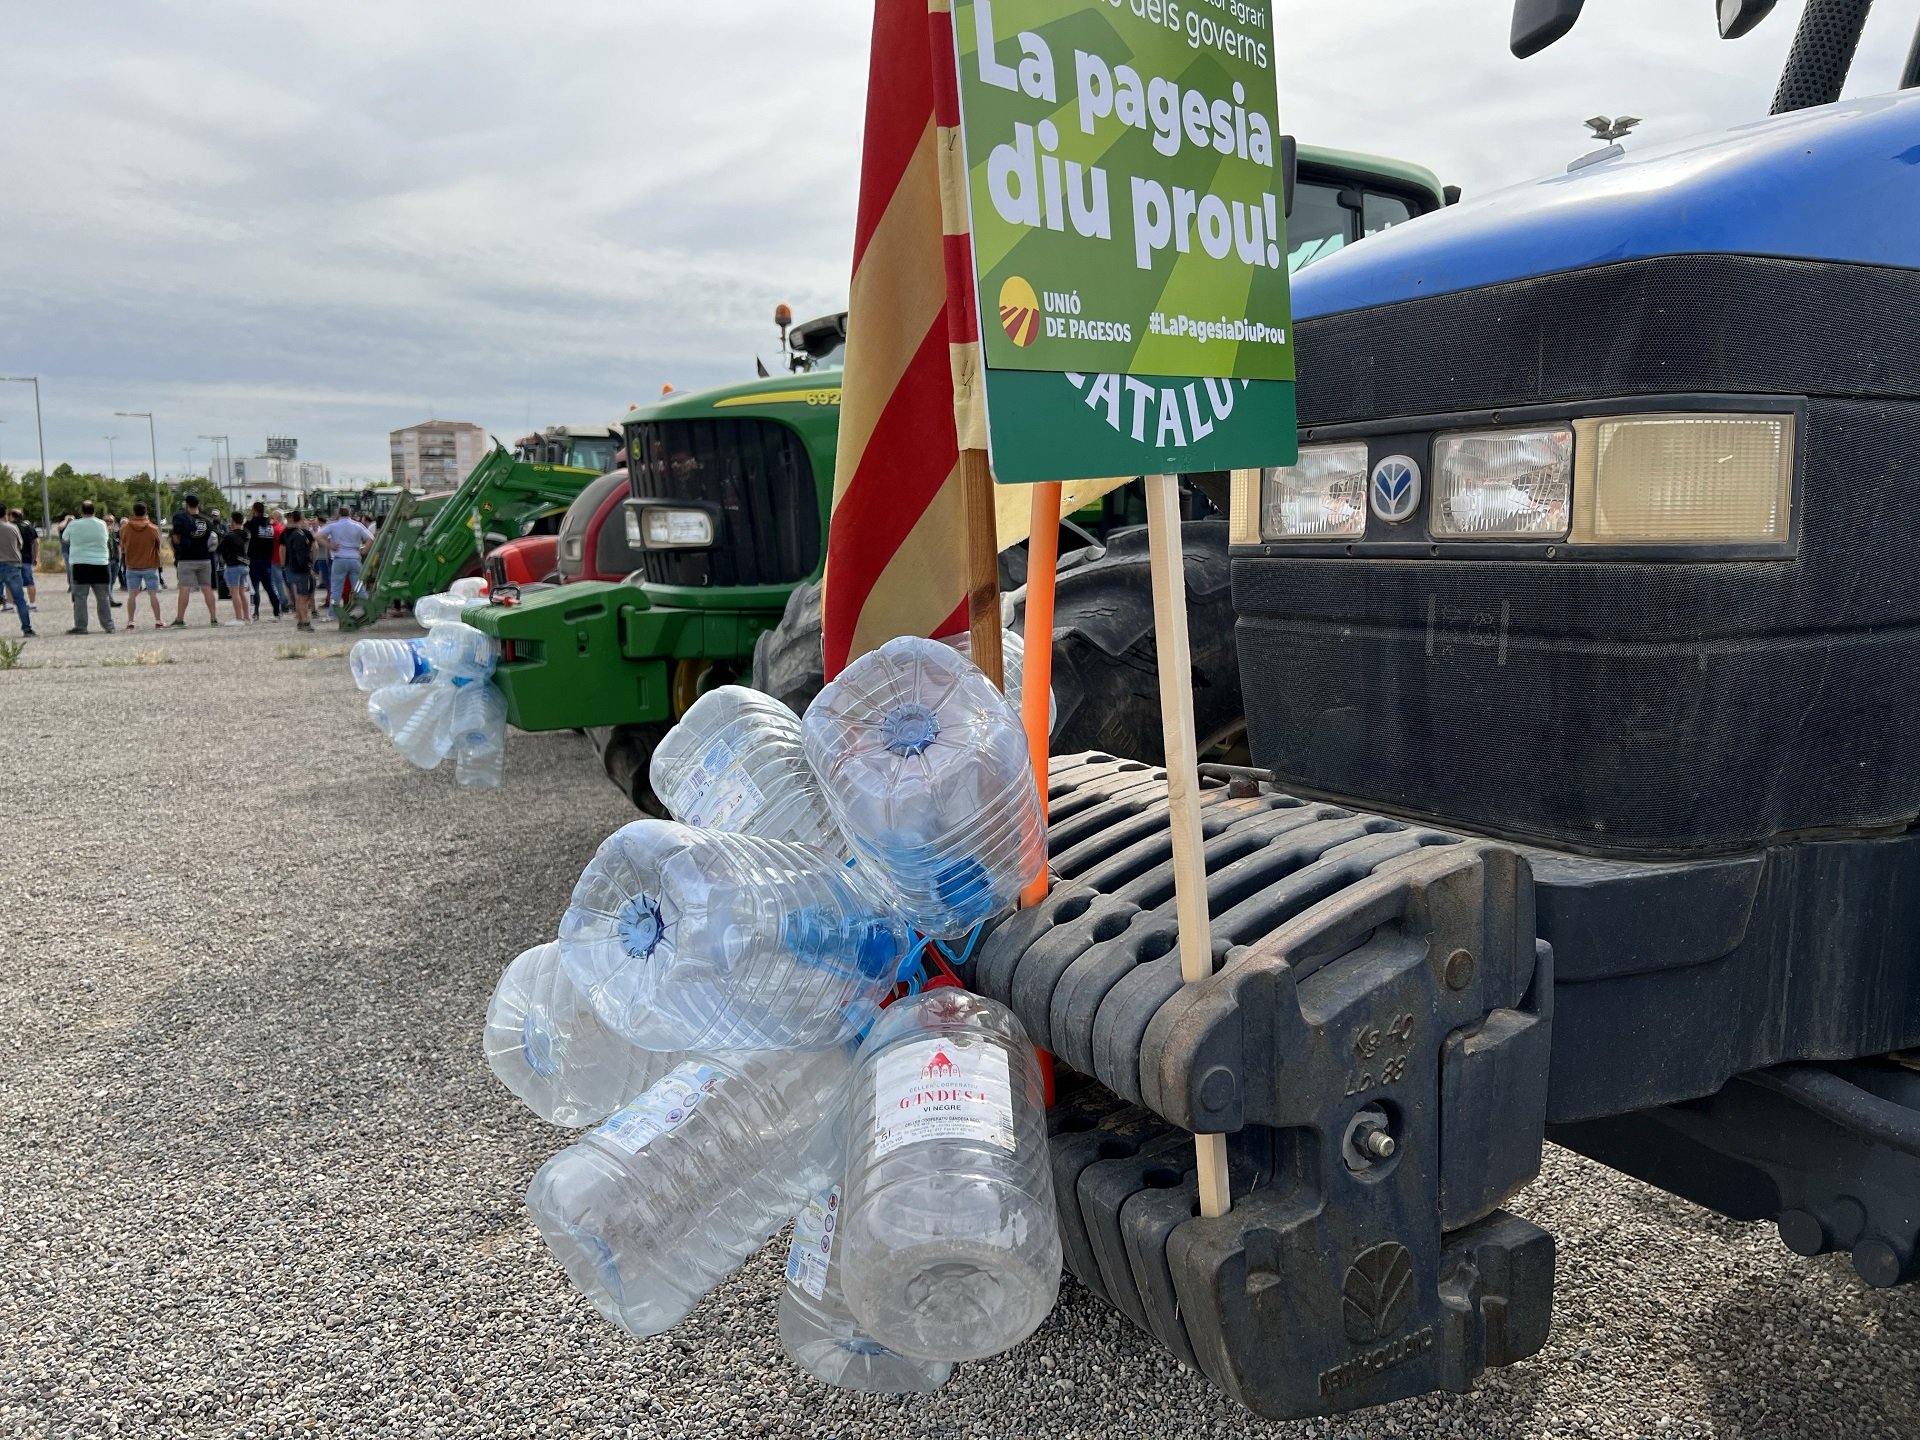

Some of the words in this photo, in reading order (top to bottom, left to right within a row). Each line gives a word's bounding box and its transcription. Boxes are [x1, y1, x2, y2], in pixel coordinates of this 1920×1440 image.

[1230, 0, 1265, 30] agrari
[1130, 0, 1180, 31] dels
[1186, 11, 1267, 69] governs
[974, 0, 1056, 103] La
[1074, 49, 1273, 168] pagesia
[987, 119, 1112, 240] diu
[1130, 175, 1280, 270] prou!
[1043, 290, 1081, 315] UNIÓ
[1046, 316, 1067, 338] DE
[1069, 319, 1132, 343] PAGESOS
[1149, 312, 1286, 345] #LaPagesiaDiuProu
[899, 1089, 986, 1109] GANDESA
